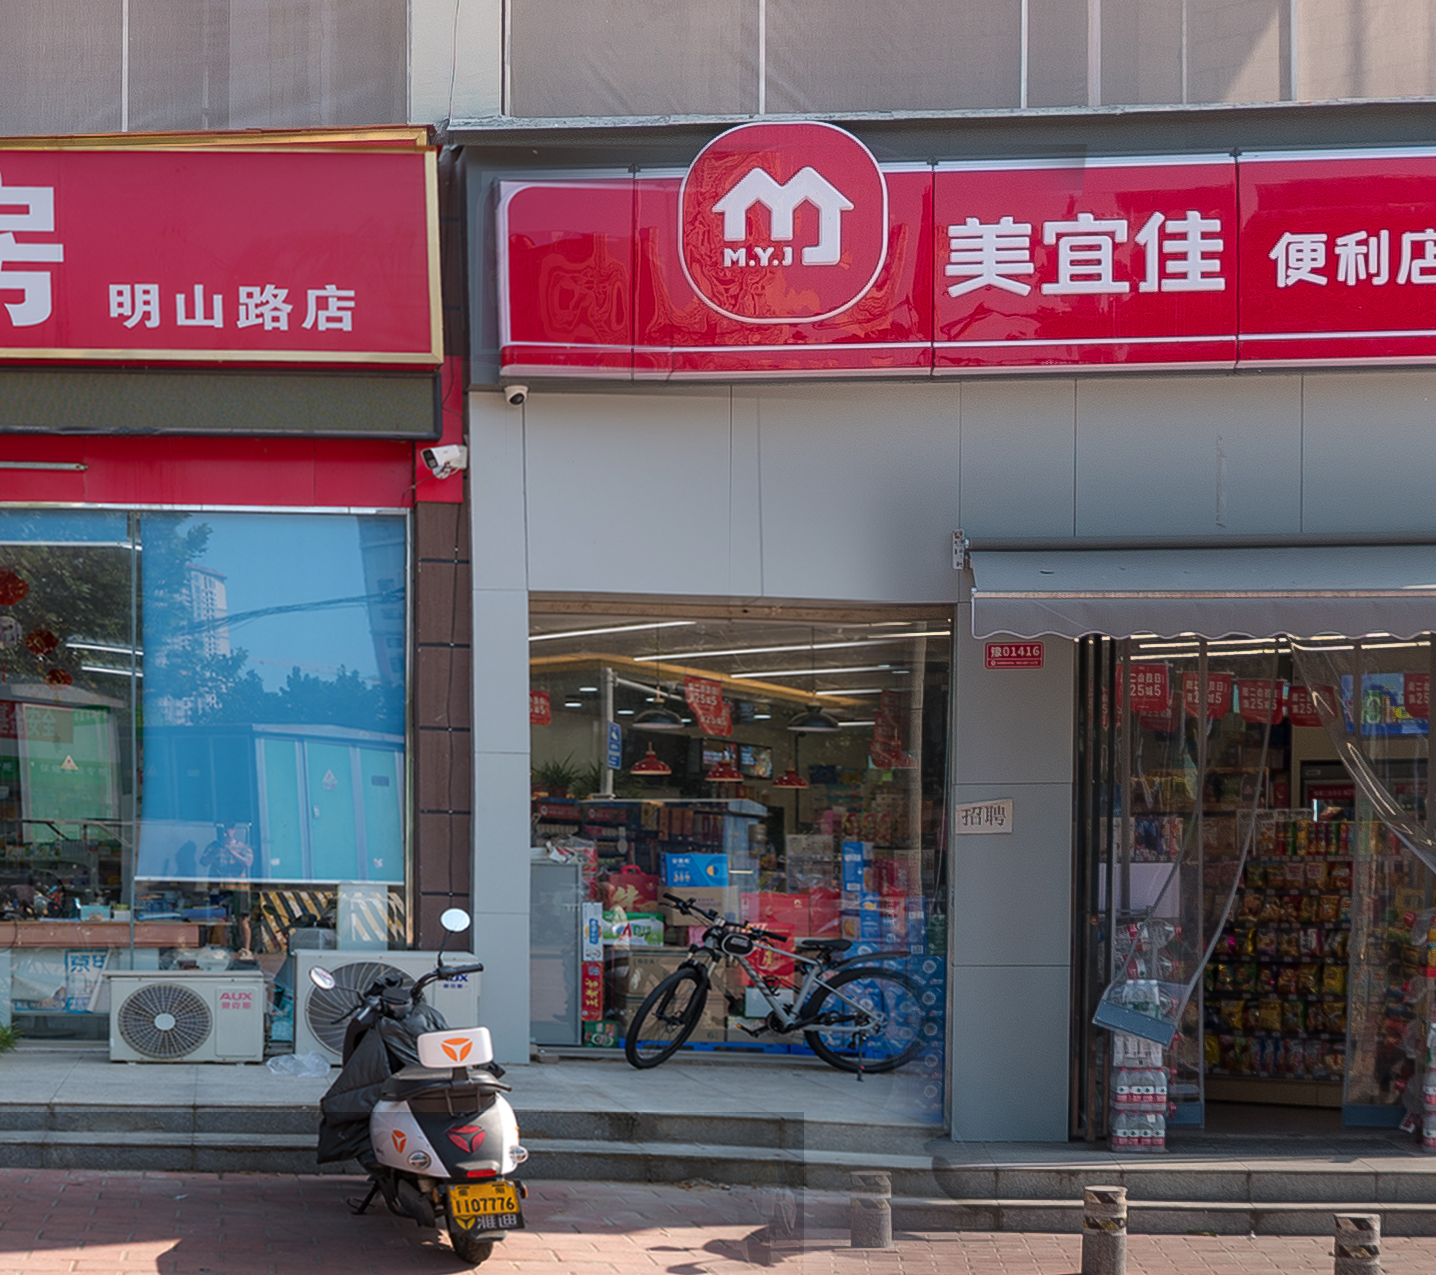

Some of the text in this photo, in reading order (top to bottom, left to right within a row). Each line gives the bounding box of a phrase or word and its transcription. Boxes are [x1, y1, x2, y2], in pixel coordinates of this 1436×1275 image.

[944, 211, 1226, 298] 美宜佳
[107, 279, 357, 332] 明山路店
[219, 992, 253, 1001] AUX
[455, 1196, 516, 1215] 1107776
